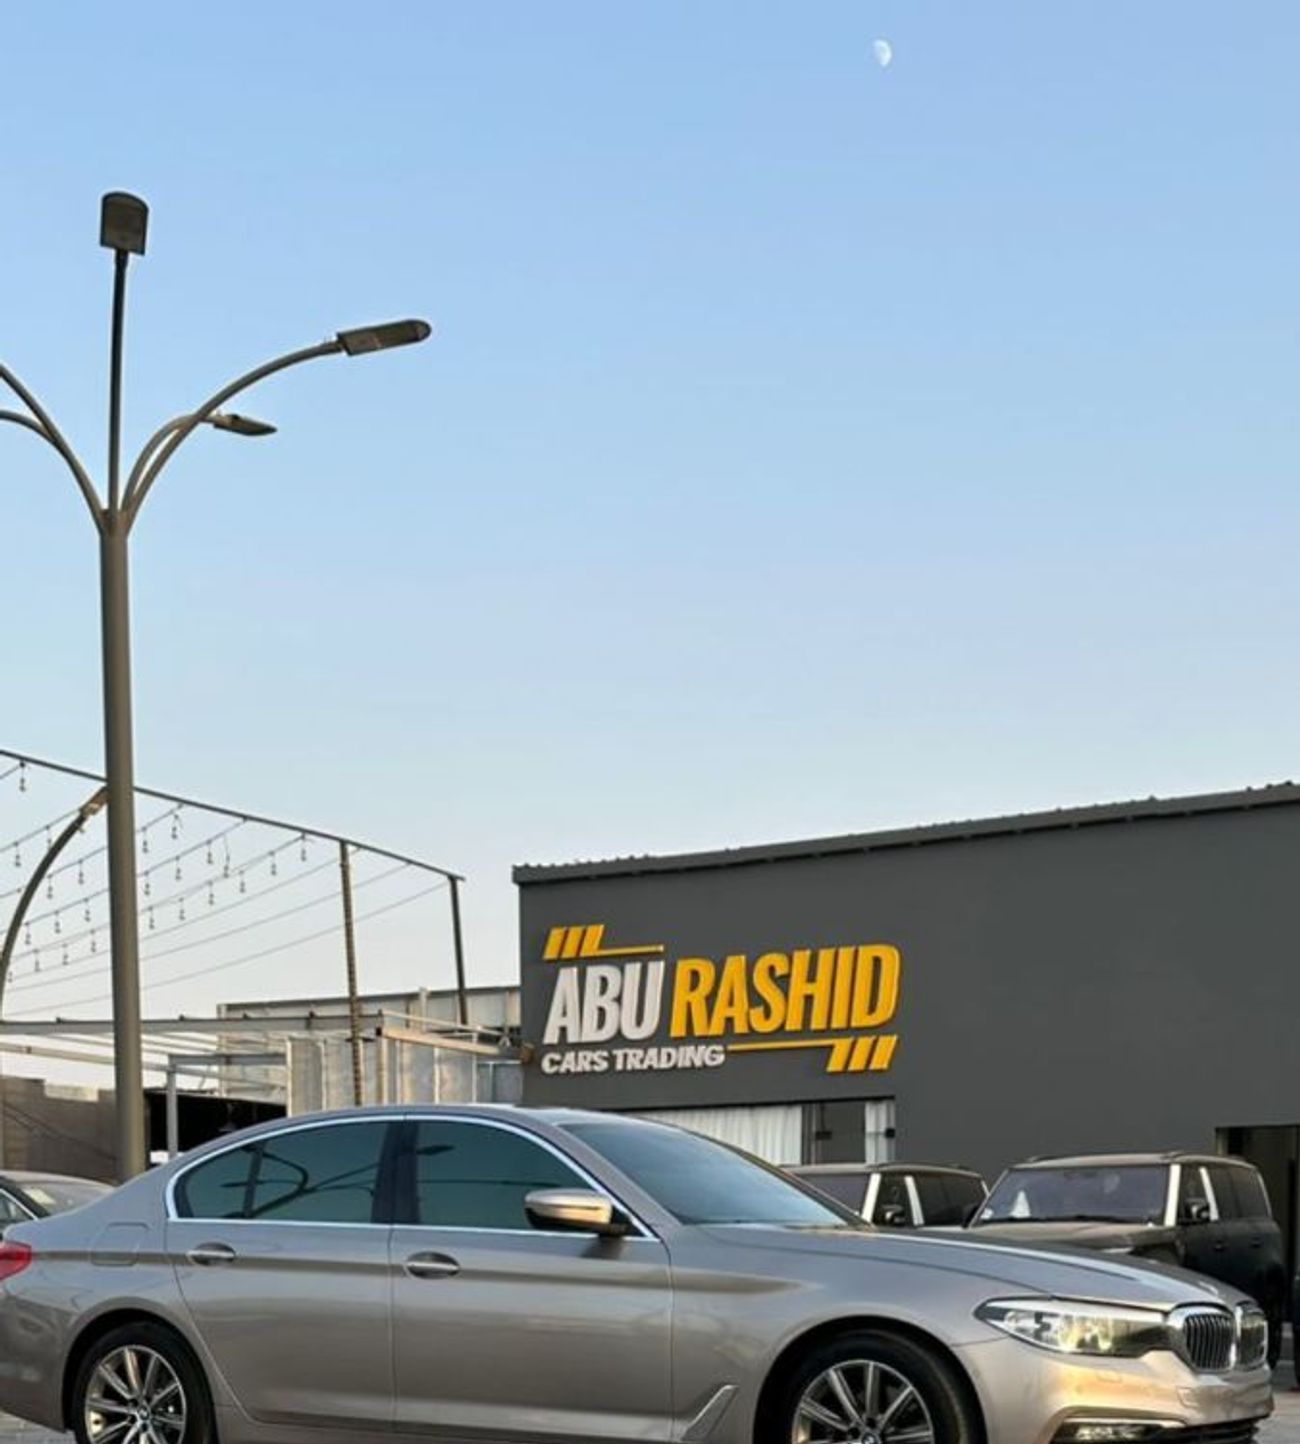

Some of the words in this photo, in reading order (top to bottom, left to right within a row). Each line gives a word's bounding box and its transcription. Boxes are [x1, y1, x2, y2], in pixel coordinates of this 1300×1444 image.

[543, 961, 665, 1044] ABU
[670, 944, 900, 1038] RASHID
[541, 1048, 608, 1074] CARS
[613, 1045, 726, 1072] TRADING
